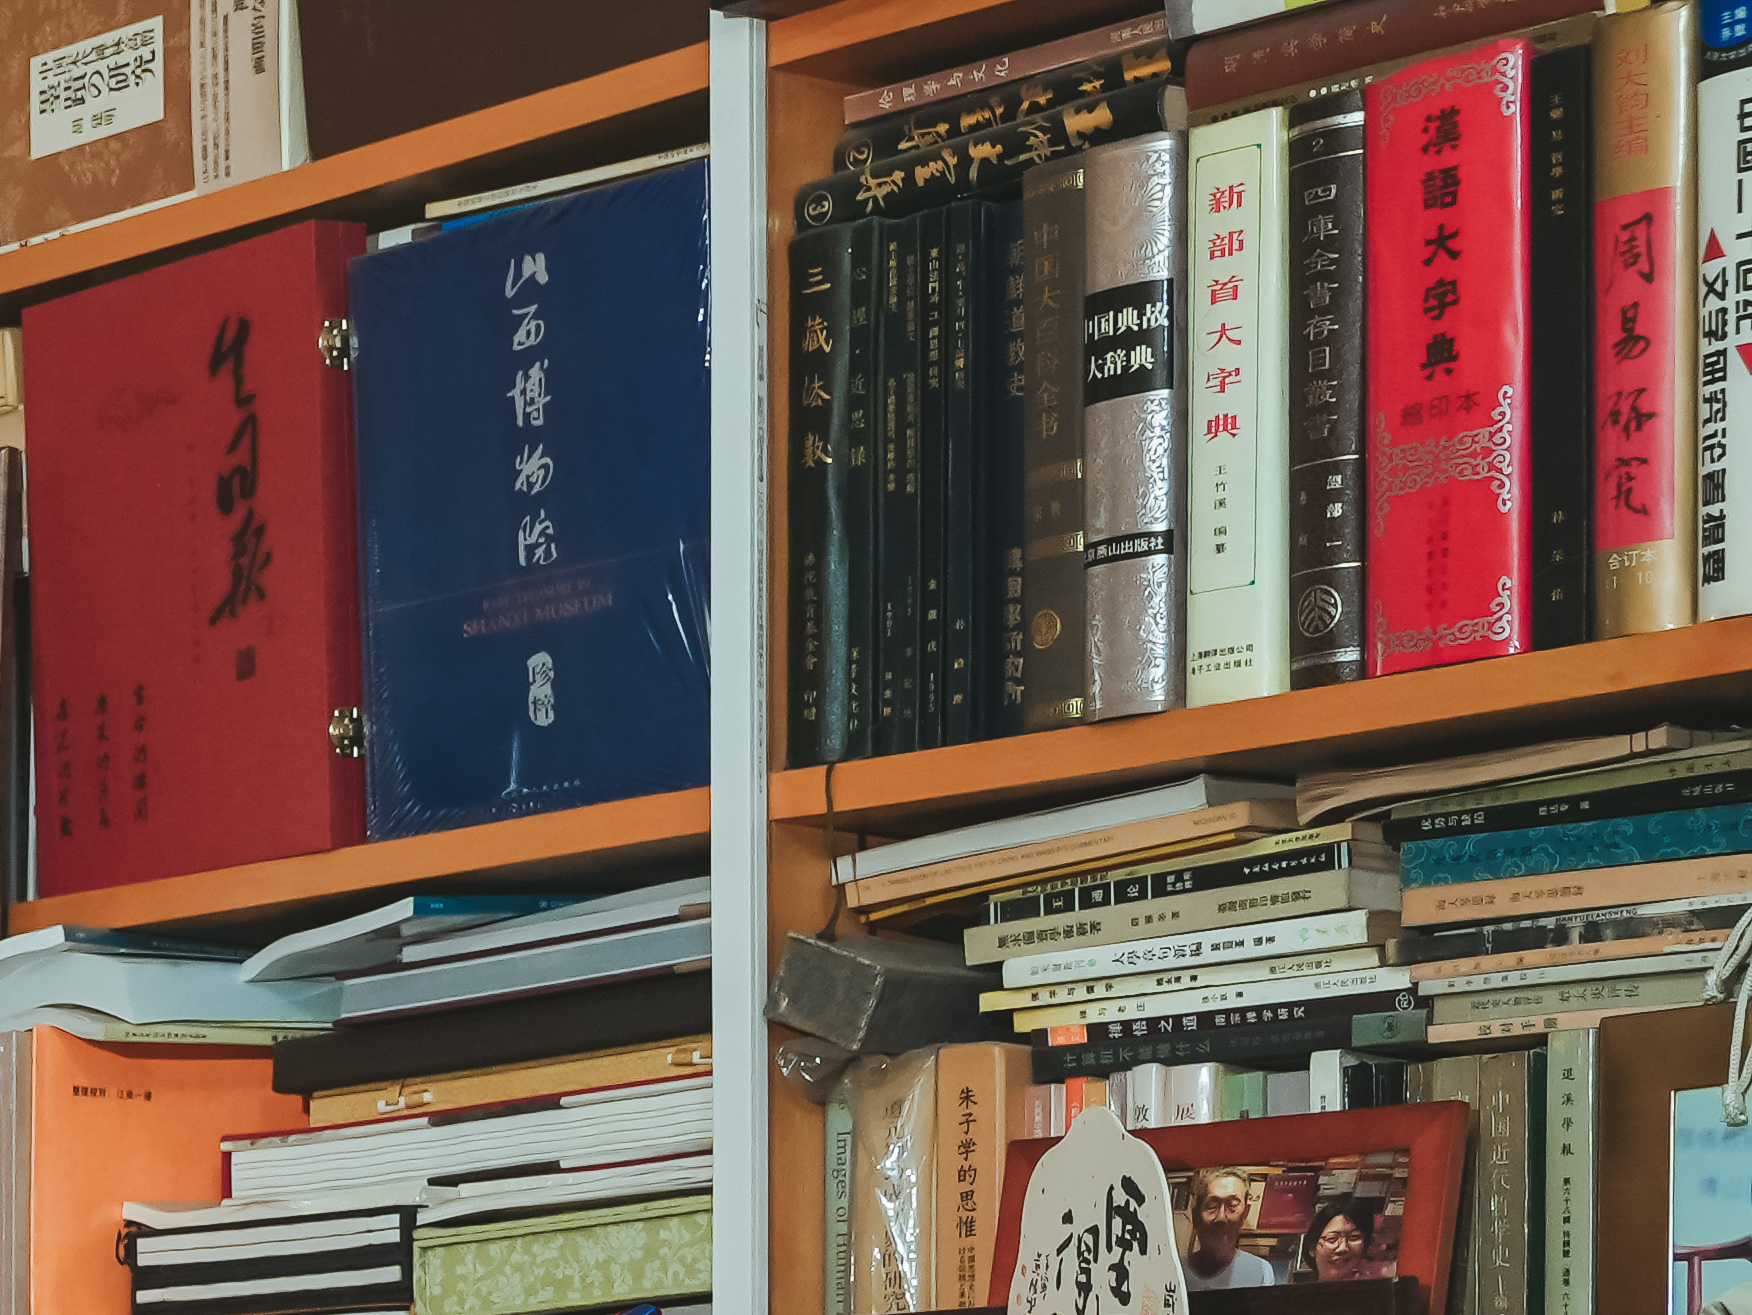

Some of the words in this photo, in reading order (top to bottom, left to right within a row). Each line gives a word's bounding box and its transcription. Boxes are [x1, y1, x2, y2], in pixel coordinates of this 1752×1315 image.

[879, 57, 1010, 110] 伦理学与文化
[1420, 107, 1461, 382] 漢語大字典
[802, 267, 833, 465] 三藏法數
[1086, 346, 1155, 380] 大辞典
[1204, 182, 1246, 443] 新部首大字典
[1302, 184, 1336, 441] 四庫全書存目叢書
[506, 252, 558, 567] 山西博物院
[1084, 535, 1165, 565] 京燕山出版社
[462, 606, 529, 638] SHANXI
[535, 592, 615, 623] MUSEUM
[1108, 1015, 1198, 1039] 禅悟之道
[831, 1130, 852, 1192] Images
[956, 1086, 979, 1240] 朱子学的思惟
